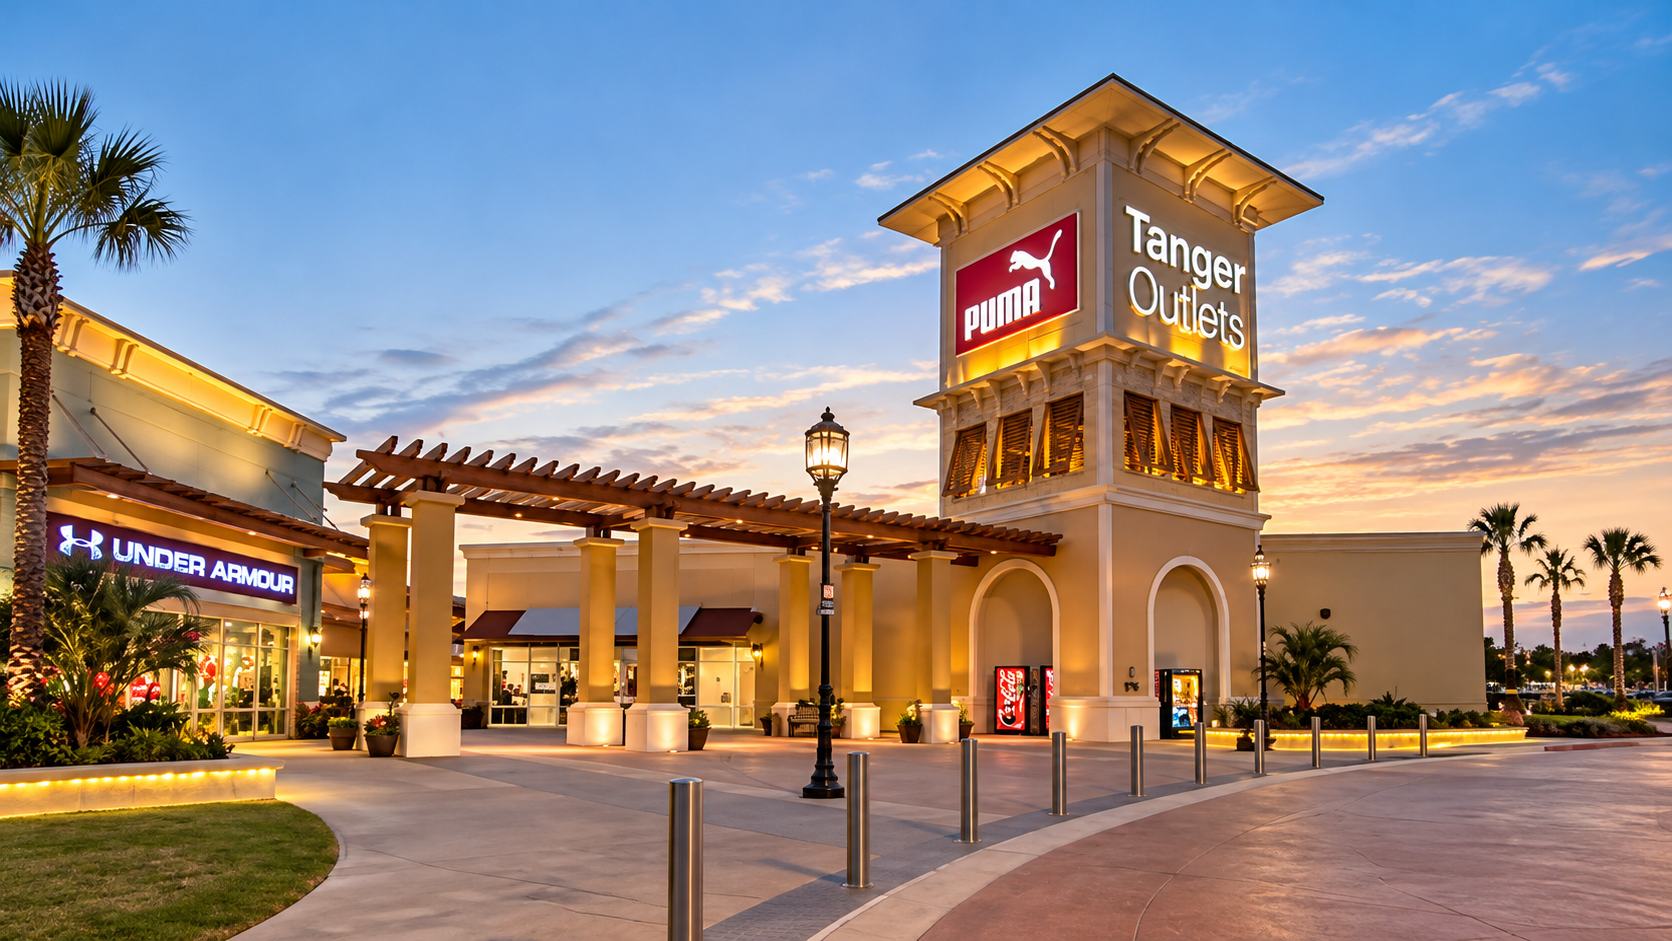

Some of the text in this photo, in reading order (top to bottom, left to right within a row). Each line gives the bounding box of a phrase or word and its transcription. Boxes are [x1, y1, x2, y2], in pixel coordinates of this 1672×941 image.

[1125, 205, 1246, 294] Tanger
[964, 277, 1041, 342] PUMA
[1129, 266, 1245, 350] Outlets
[112, 537, 294, 594] UNDER ARMOUR
